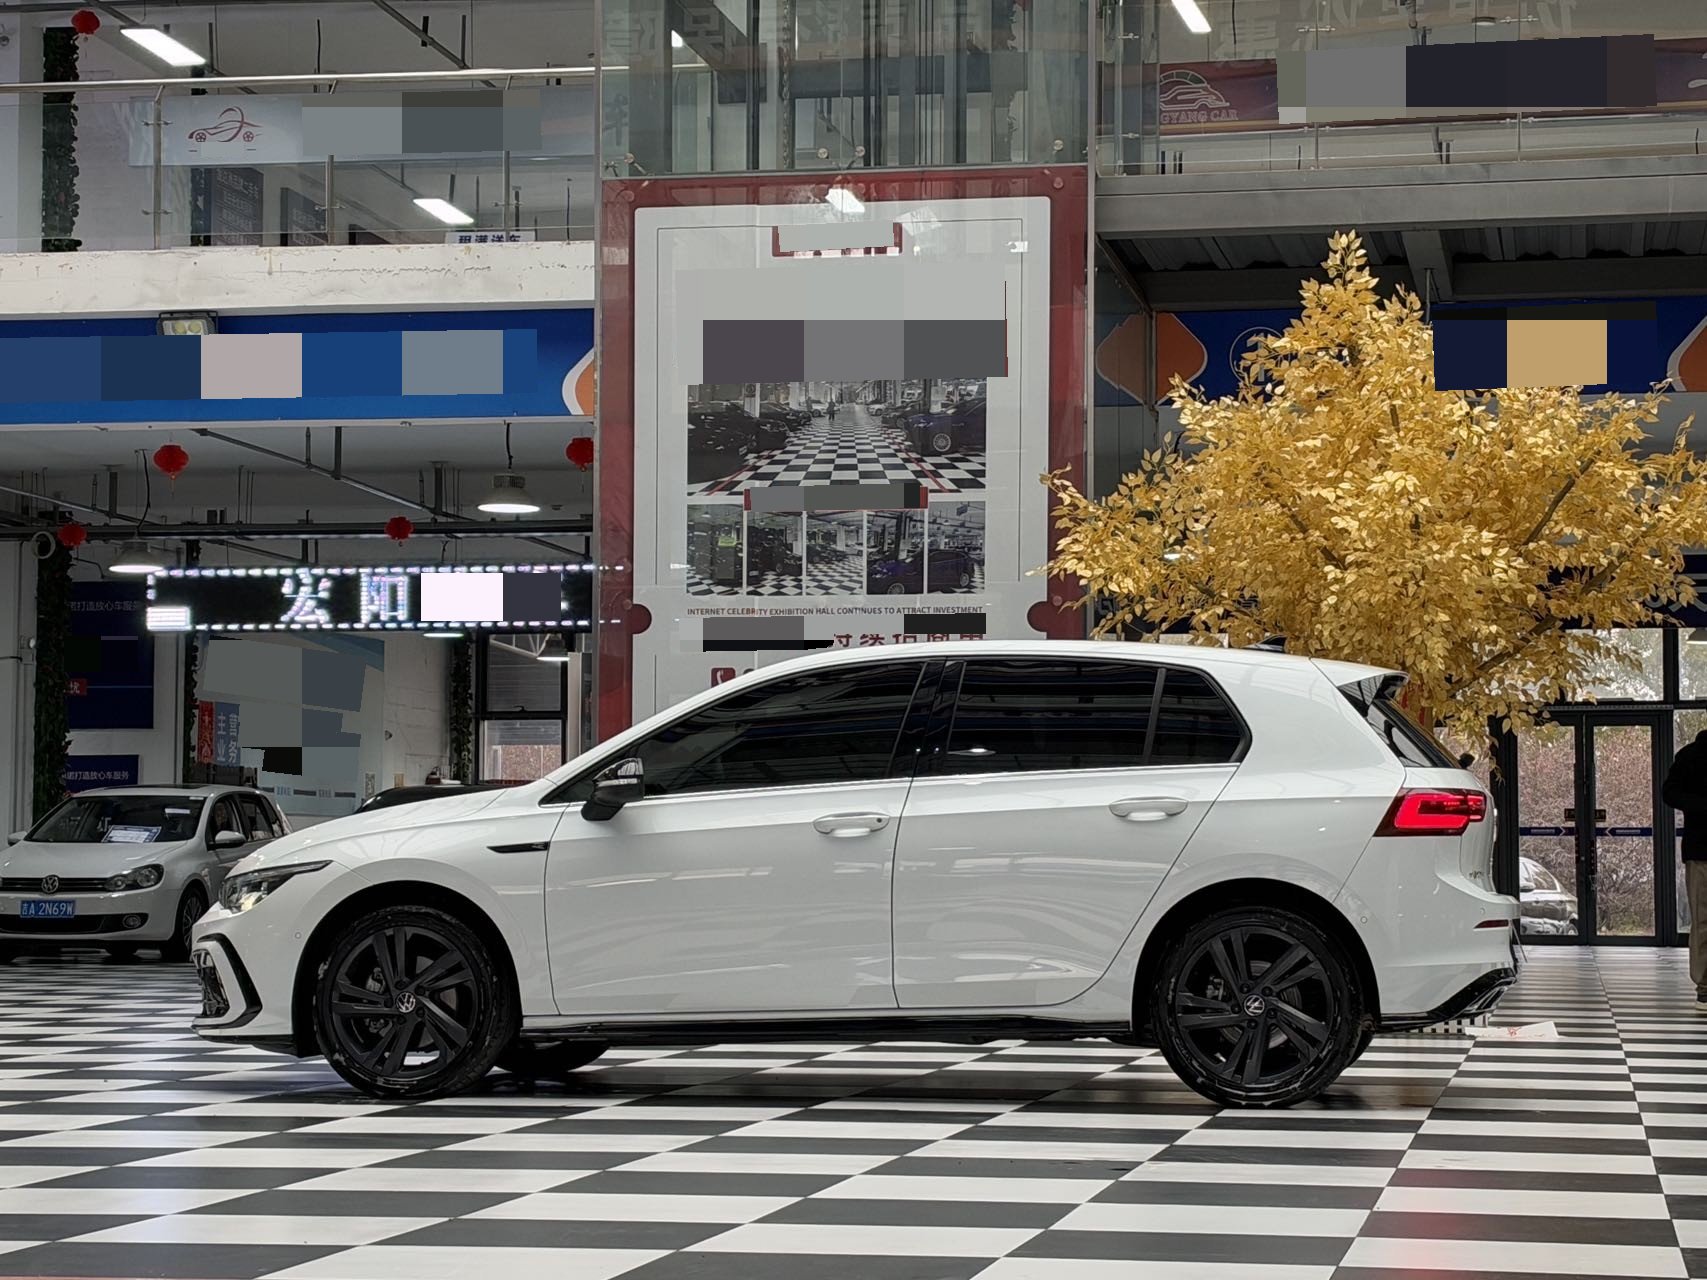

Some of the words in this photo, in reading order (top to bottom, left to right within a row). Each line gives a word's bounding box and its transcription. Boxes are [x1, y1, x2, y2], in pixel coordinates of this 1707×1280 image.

[1210, 110, 1239, 120] CAR
[687, 607, 725, 616] INTERNET
[726, 607, 768, 616] CELEBRITY
[769, 607, 814, 616] EXHIBITION
[816, 607, 835, 615] HALL
[836, 606, 883, 615] CONTINUES
[884, 606, 895, 614] TO
[896, 606, 931, 614] ATTRACT
[933, 606, 983, 614] INVESTMENT
